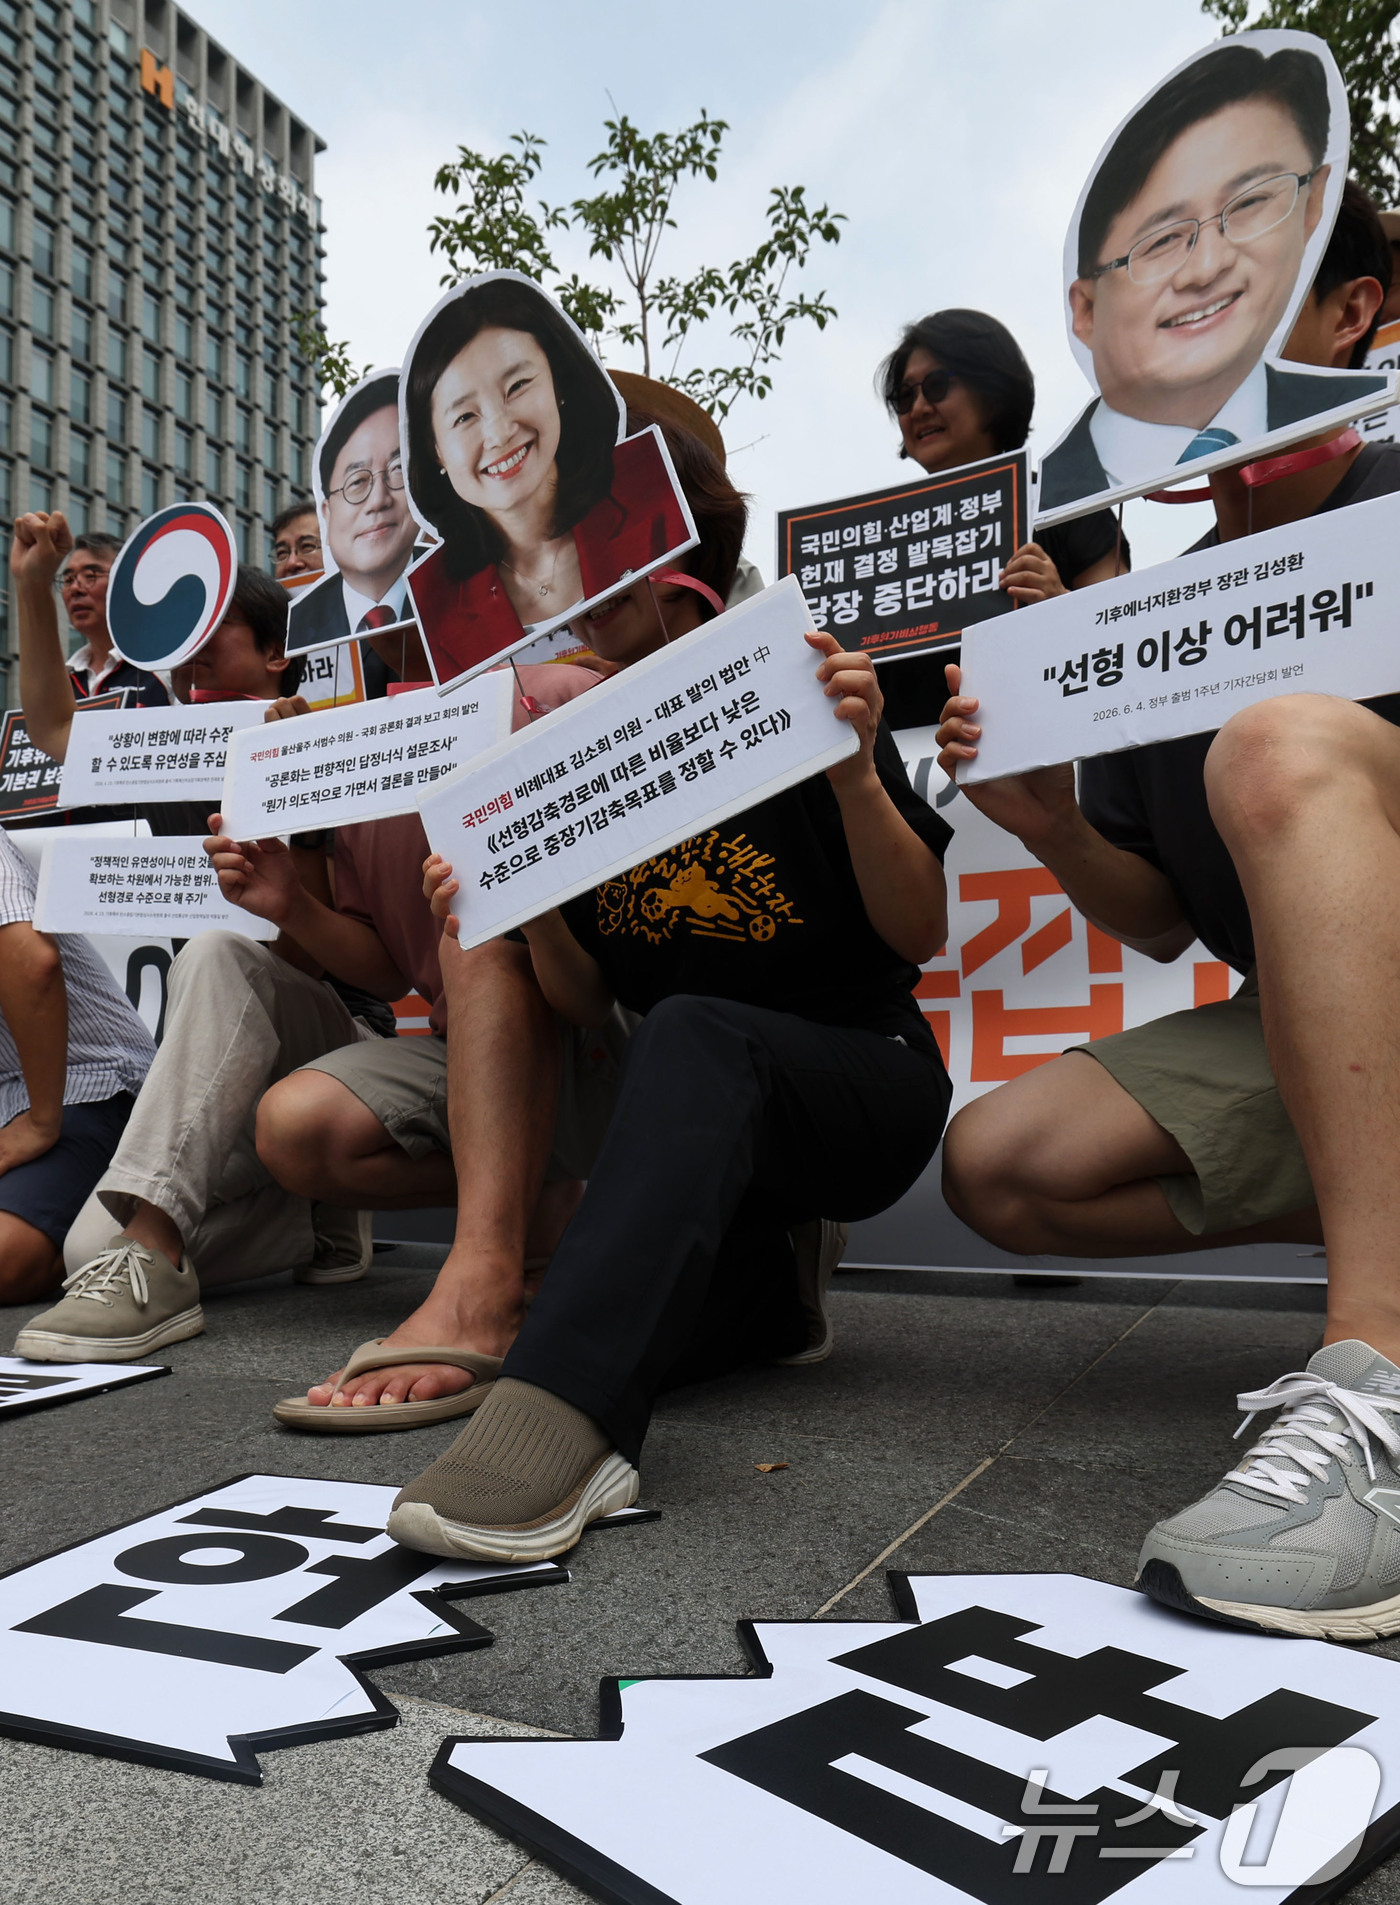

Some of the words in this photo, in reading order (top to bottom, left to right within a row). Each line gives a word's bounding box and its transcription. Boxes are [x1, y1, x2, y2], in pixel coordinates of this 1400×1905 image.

[184, 92, 317, 231] 현대해상화재
[800, 558, 845, 590] 헌재
[853, 548, 898, 580] 결정
[907, 521, 1002, 569] 발목잡기
[873, 557, 1004, 617] 중단하라
[1095, 580, 1213, 626] 기후에너지환경부
[1216, 567, 1249, 593] 장관
[1253, 552, 1305, 582] 김성환
[1043, 643, 1125, 698] "선형
[1137, 620, 1212, 673] 이상
[1224, 581, 1374, 650] 어려워"
[1093, 707, 1122, 722] 2026.
[1124, 704, 1133, 715] 6.
[1135, 701, 1146, 712] 4.
[1149, 695, 1169, 710] 정부
[1171, 689, 1192, 705] 출범
[1194, 682, 1221, 699] 1주년
[1223, 668, 1278, 693] 기자간담회
[1281, 663, 1305, 679] 발언
[108, 731, 145, 749] "상황이
[148, 729, 180, 747] 변함에
[183, 728, 207, 744] 따라
[250, 748, 279, 762] 국민의힘
[280, 740, 311, 757] 울산울주
[313, 734, 336, 749] 서범수
[337, 730, 354, 742] 의원
[361, 725, 377, 738] 국회
[379, 720, 403, 734] 공론화
[405, 716, 422, 729] 결과
[423, 712, 441, 724] 보고
[442, 706, 460, 719] 회의
[461, 702, 479, 715] 발언
[265, 765, 311, 788] "공론화는
[313, 756, 357, 780] 편향적인
[358, 747, 404, 770] 답정너식
[406, 735, 458, 760] 설문조사"
[462, 791, 515, 830] 국민의힘
[514, 761, 568, 801] 비례대표
[569, 739, 612, 771] 김소희
[613, 717, 643, 746] 의원
[654, 693, 686, 724] 대표
[685, 673, 718, 701] 발의
[718, 655, 751, 684] 법안
[753, 645, 771, 665] 中
[610, 753, 647, 783] 따른
[649, 713, 719, 763] 비율보다
[721, 690, 760, 723] 낮은
[0, 766, 41, 792] 기본권
[91, 757, 102, 773] 할
[106, 758, 117, 773] 수
[119, 755, 152, 772] 있도록
[155, 752, 201, 770] 유연성을
[261, 796, 287, 813] "뭔가
[288, 786, 342, 807] 의도적으로
[344, 777, 378, 797] 가면서
[380, 771, 415, 790] 결론을
[479, 846, 542, 892] 수준으로
[543, 771, 677, 856] 중장기감축목표를
[678, 749, 716, 782] 정할
[719, 737, 737, 760] 수
[89, 873, 125, 886] 확보하는
[127, 874, 162, 886] 차원에서
[164, 874, 192, 887] 가능한
[90, 856, 129, 869] "정책적인
[131, 856, 176, 869] 유연성이나
[177, 856, 196, 869] 이런
[98, 891, 134, 904] 선형경로
[136, 892, 172, 904] 수준으로
[173, 892, 183, 905] 해
[184, 893, 208, 905] 주기"
